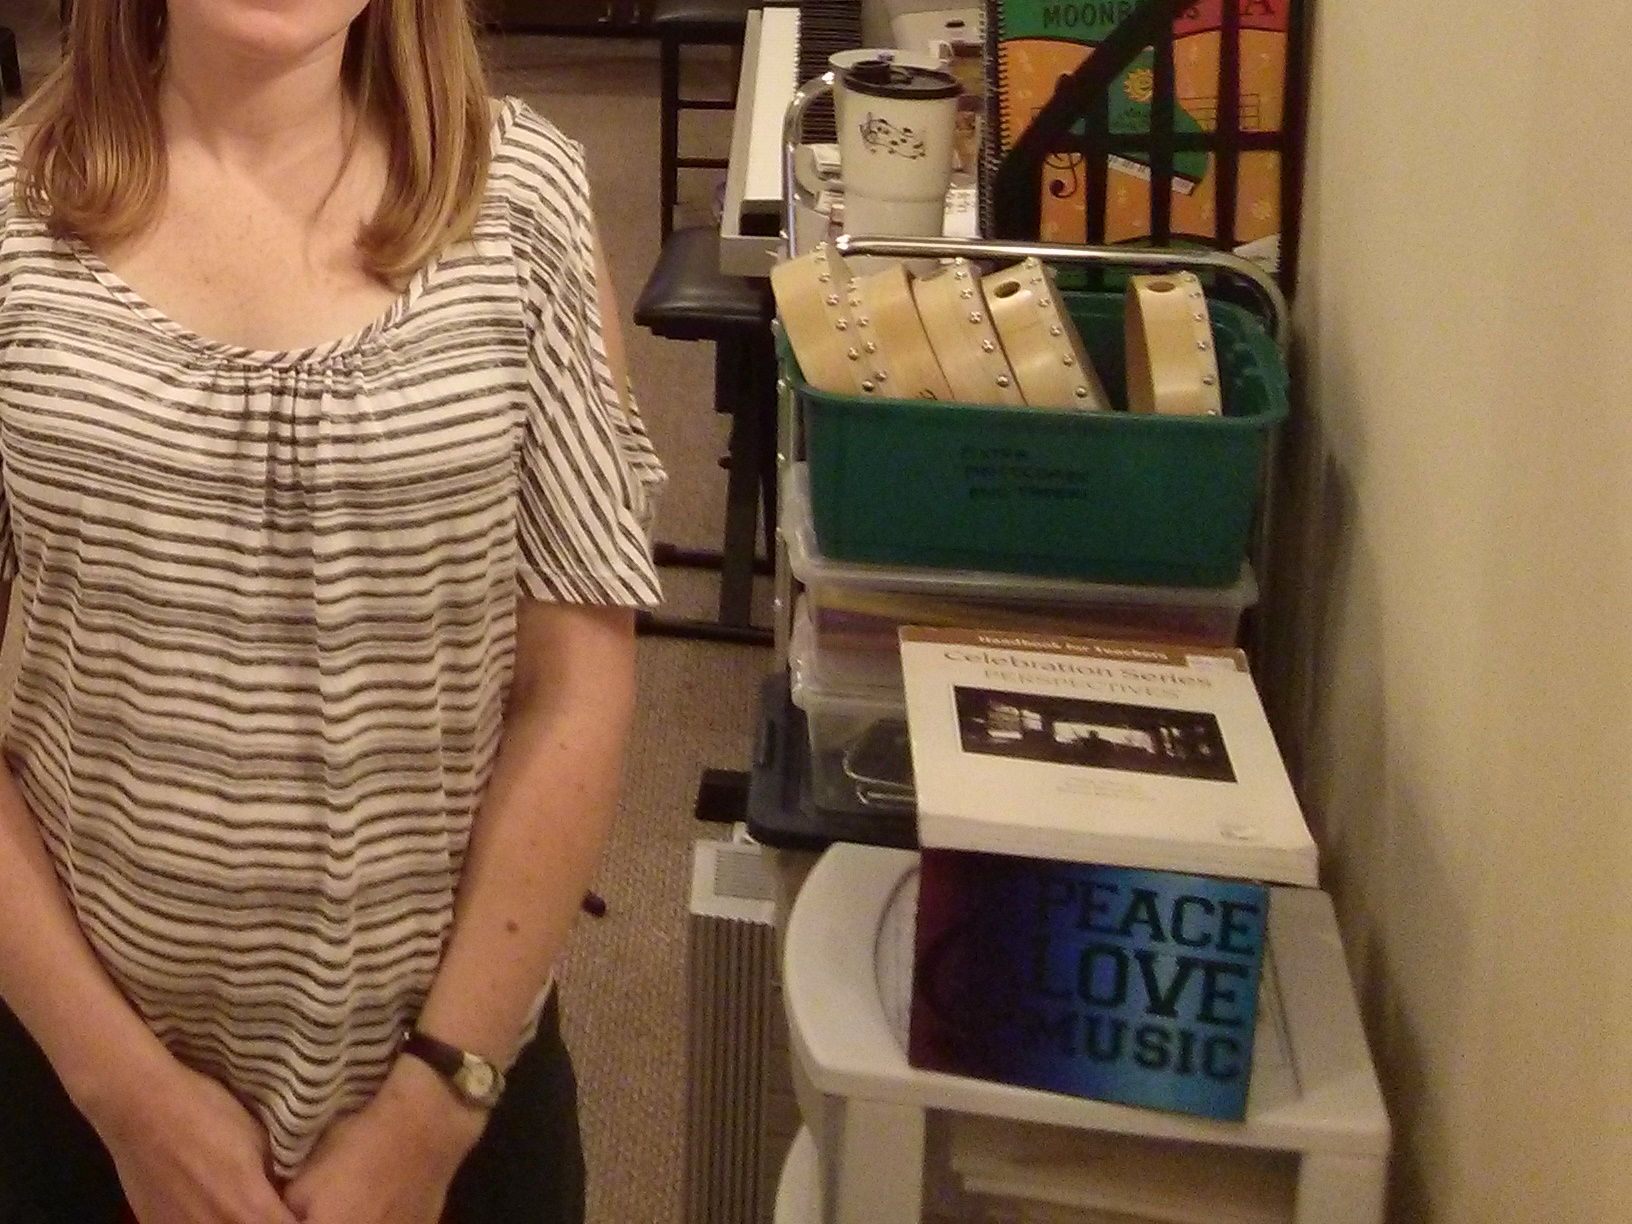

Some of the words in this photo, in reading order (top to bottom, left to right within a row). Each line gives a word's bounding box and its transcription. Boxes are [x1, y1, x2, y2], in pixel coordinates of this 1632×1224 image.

[943, 649, 1114, 678] Celebration
[1121, 665, 1213, 688] Series
[1036, 876, 1260, 956] PEACE
[1028, 934, 1250, 1028] LOVE
[1024, 1006, 1243, 1082] MUSIC
